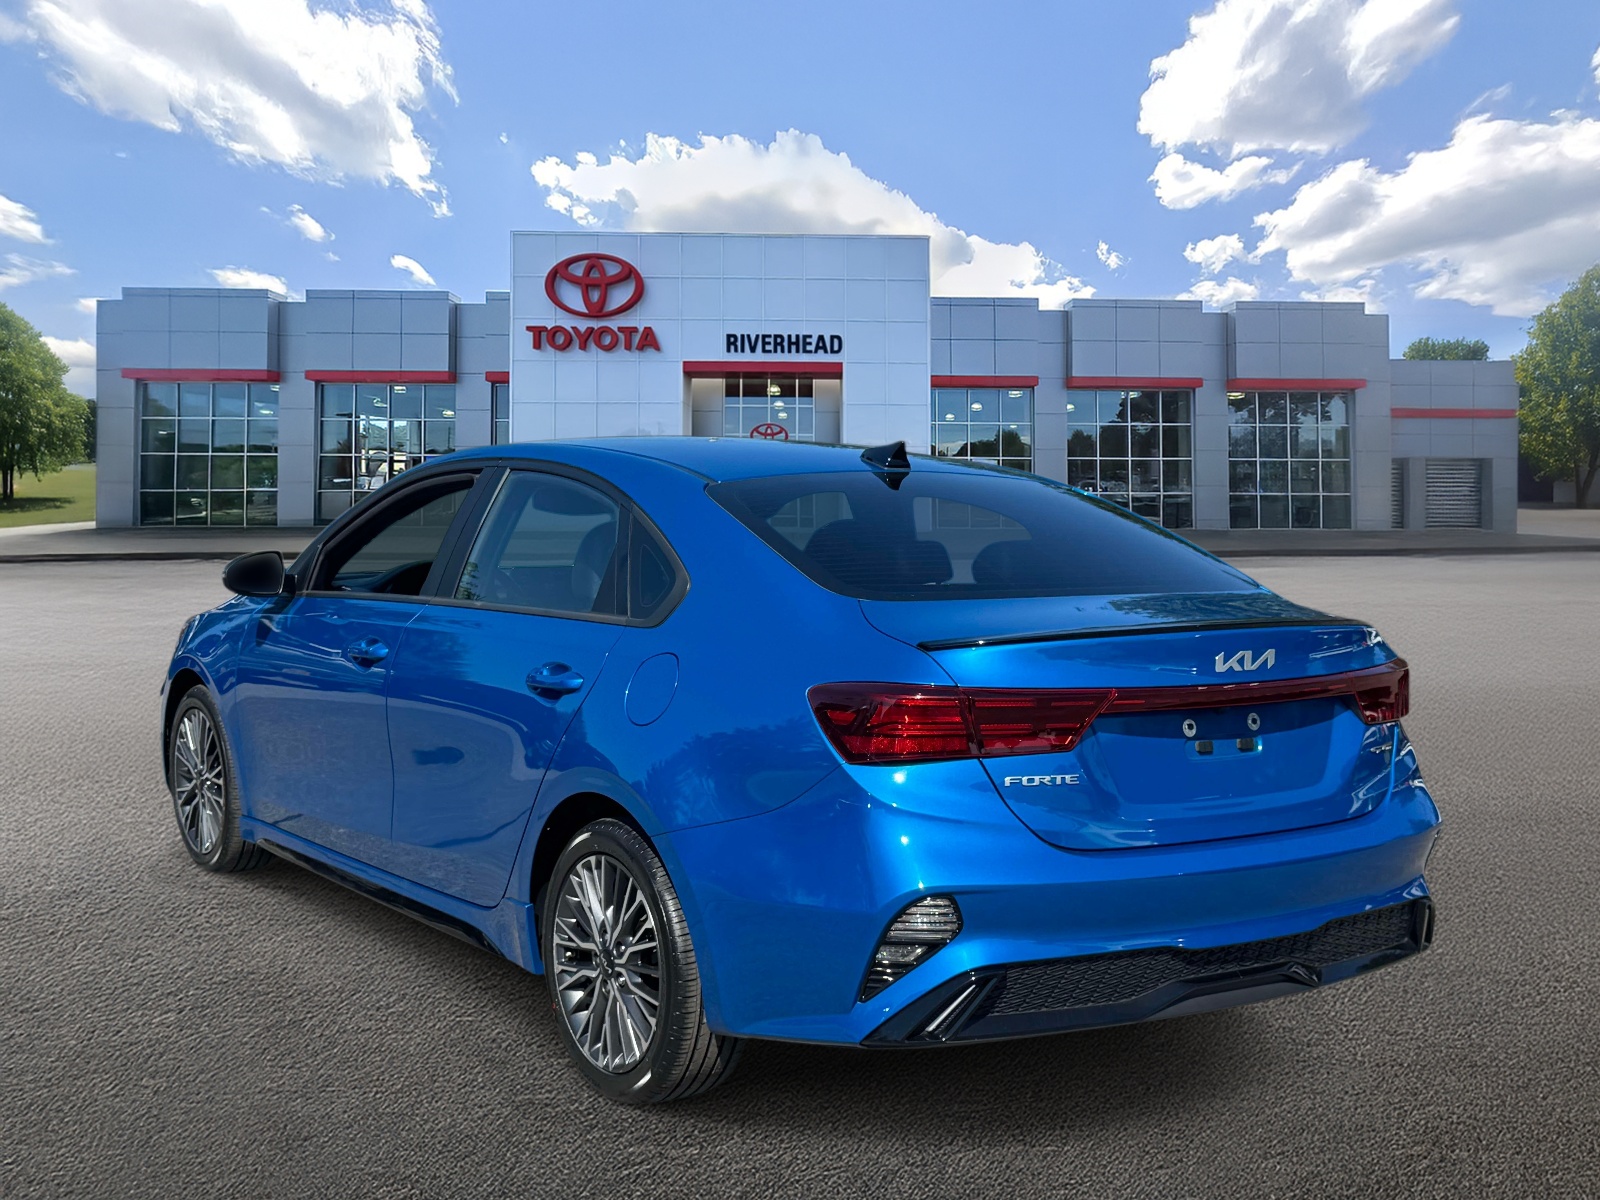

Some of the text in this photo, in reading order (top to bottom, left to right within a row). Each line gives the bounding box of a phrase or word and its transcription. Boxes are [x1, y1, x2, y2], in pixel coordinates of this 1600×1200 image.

[526, 326, 661, 352] TOYOTA
[725, 333, 843, 354] RIVERHEAD
[1215, 649, 1276, 673] KIA
[1004, 774, 1080, 787] FORTE
